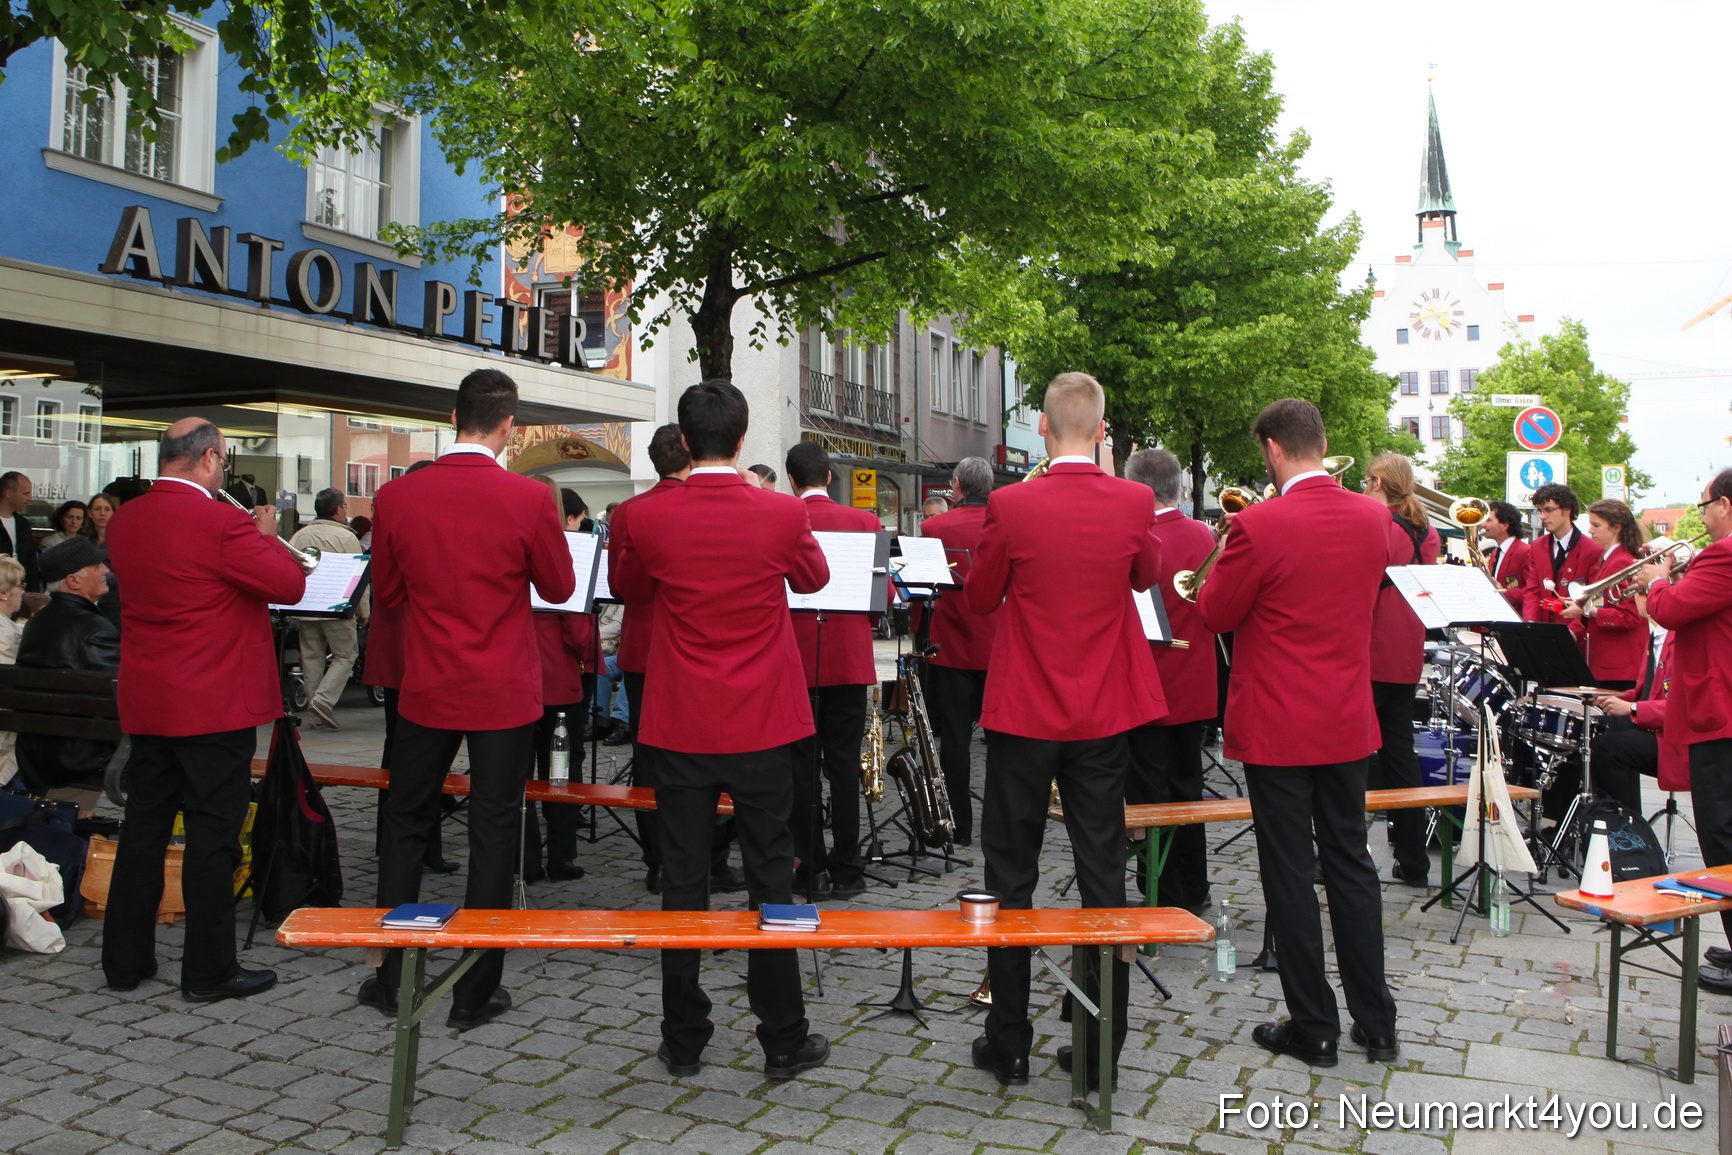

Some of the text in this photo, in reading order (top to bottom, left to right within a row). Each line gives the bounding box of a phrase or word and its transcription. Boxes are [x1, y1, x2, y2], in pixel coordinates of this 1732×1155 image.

[101, 205, 590, 369] ANTON PETER
[1495, 396, 1534, 404] Ulmer Gasse
